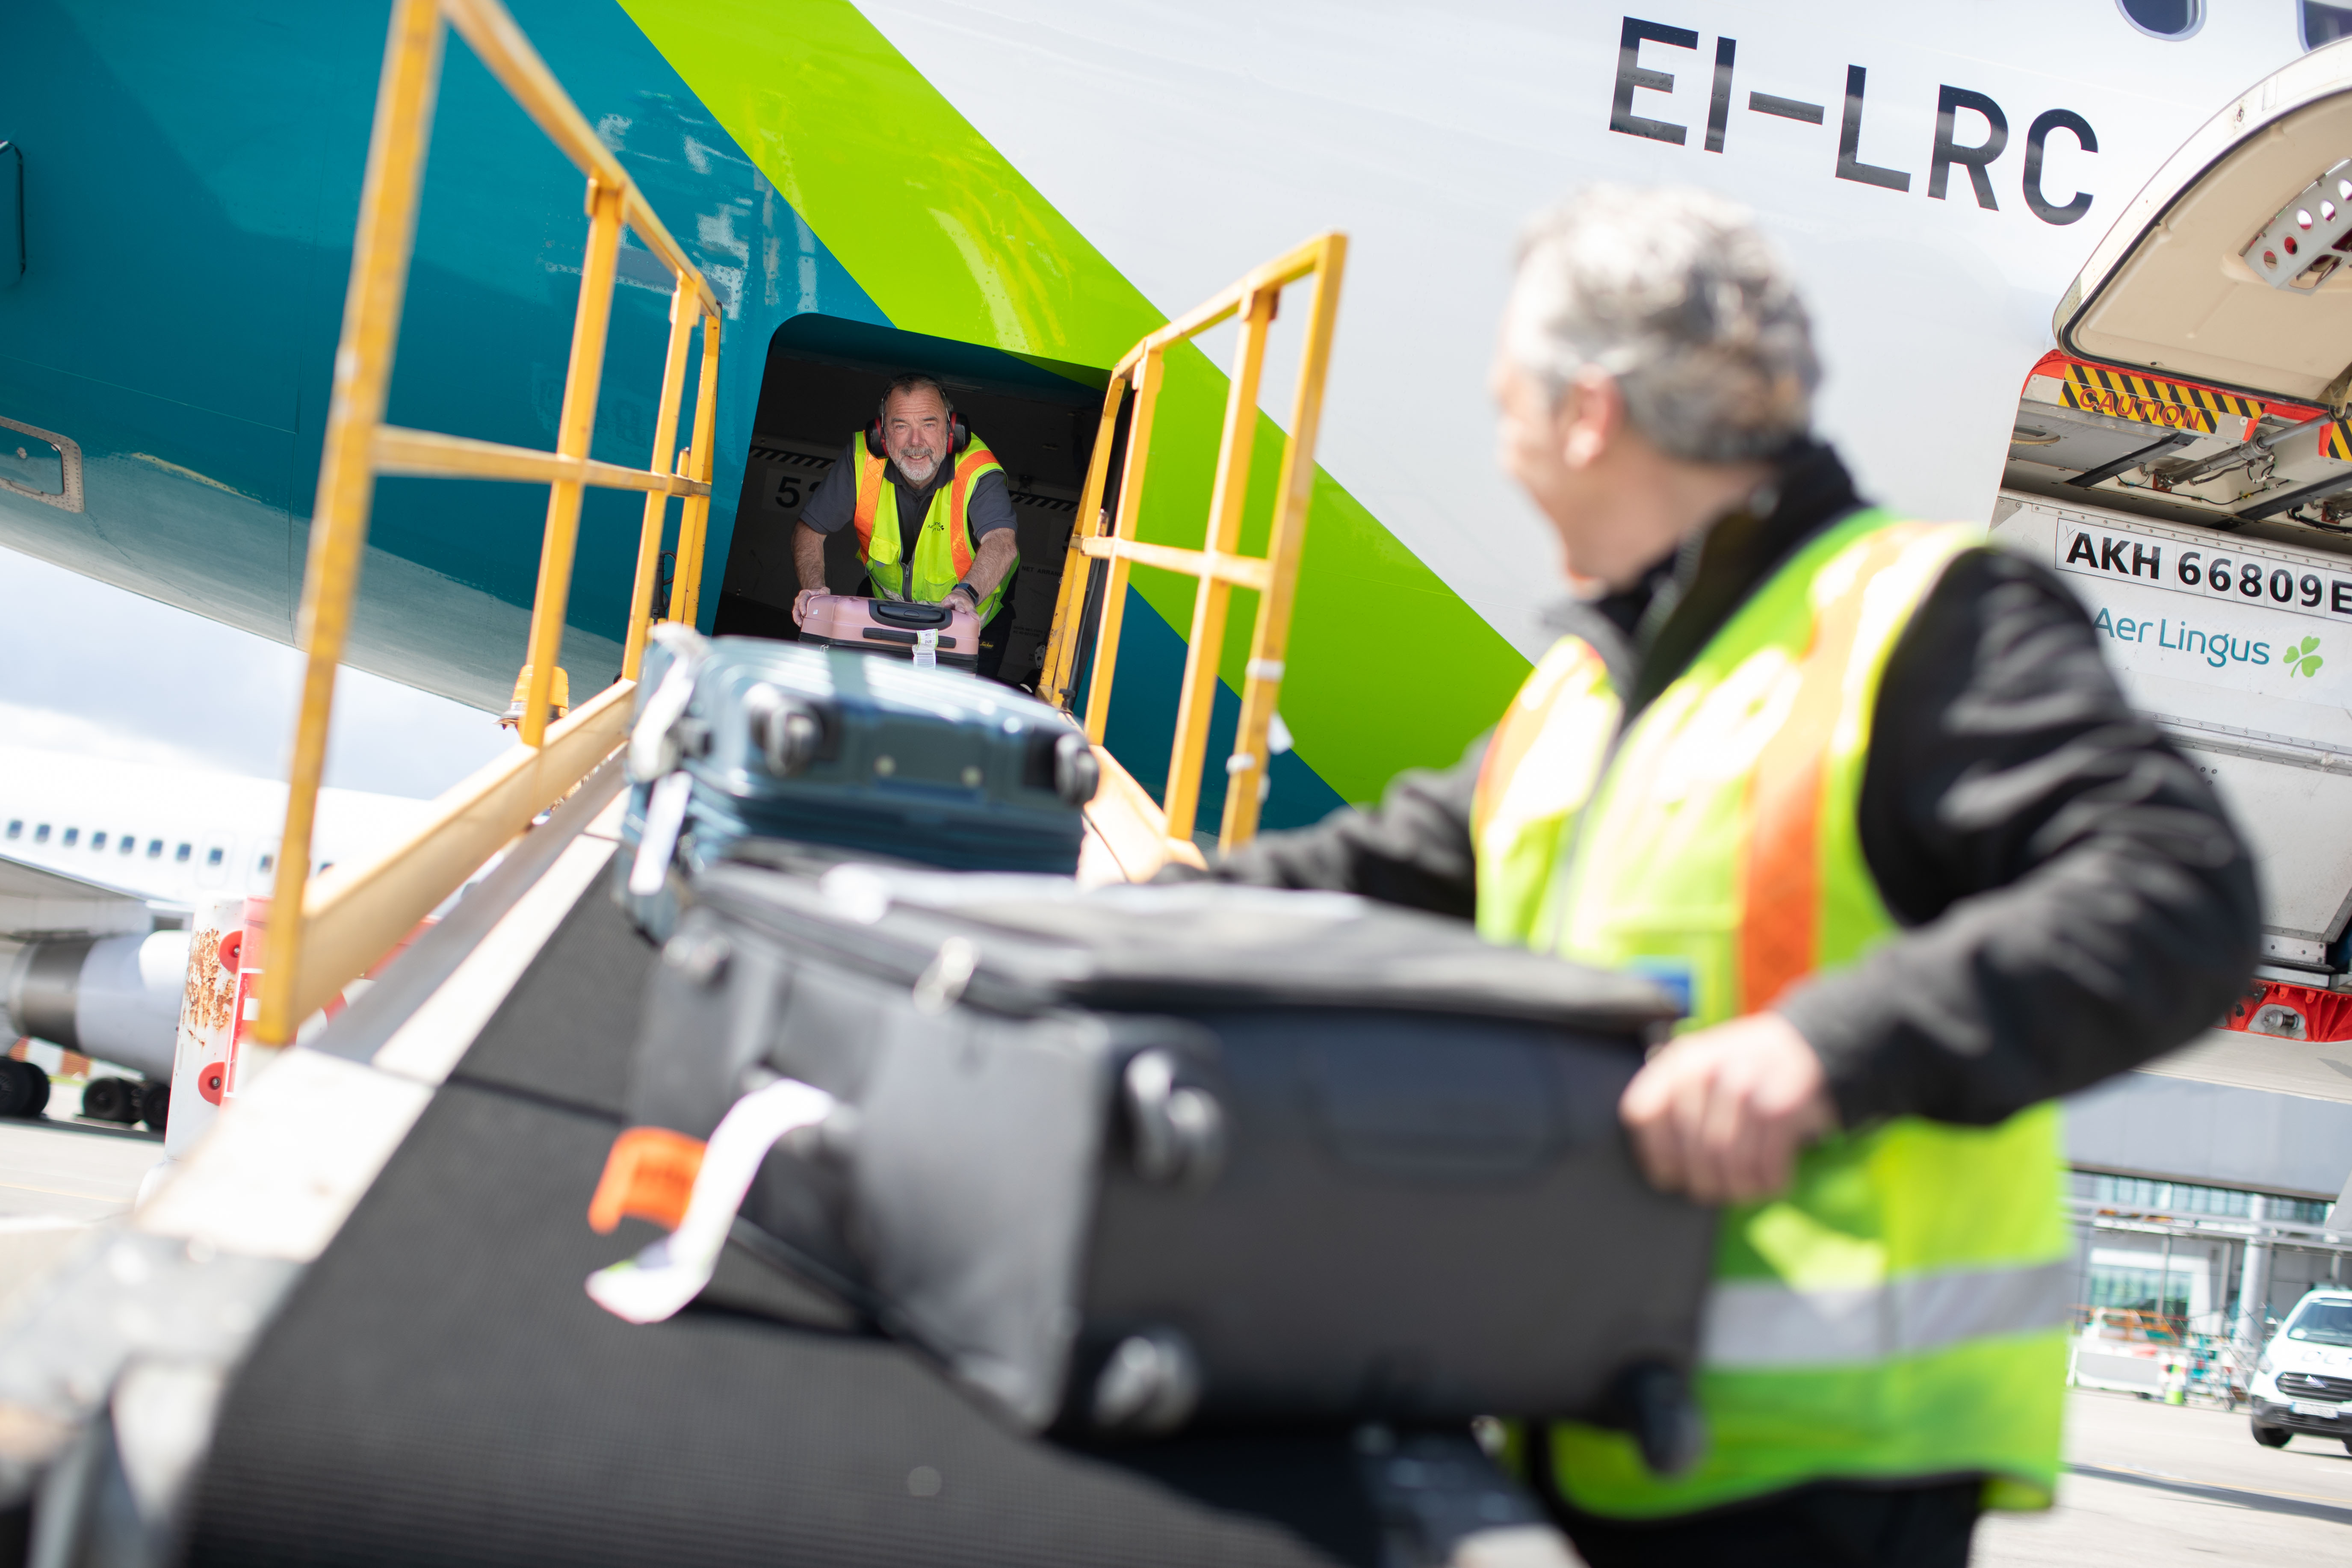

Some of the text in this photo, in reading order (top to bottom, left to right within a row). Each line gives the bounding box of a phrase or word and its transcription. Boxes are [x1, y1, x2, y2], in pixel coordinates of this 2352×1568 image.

[1609, 16, 2098, 226] EI-LRC
[2079, 388, 2202, 429] CAUTION
[775, 475, 821, 508] 5
[2066, 532, 2352, 615] AKH 66809E
[2094, 607, 2270, 667] Aer Lingus
